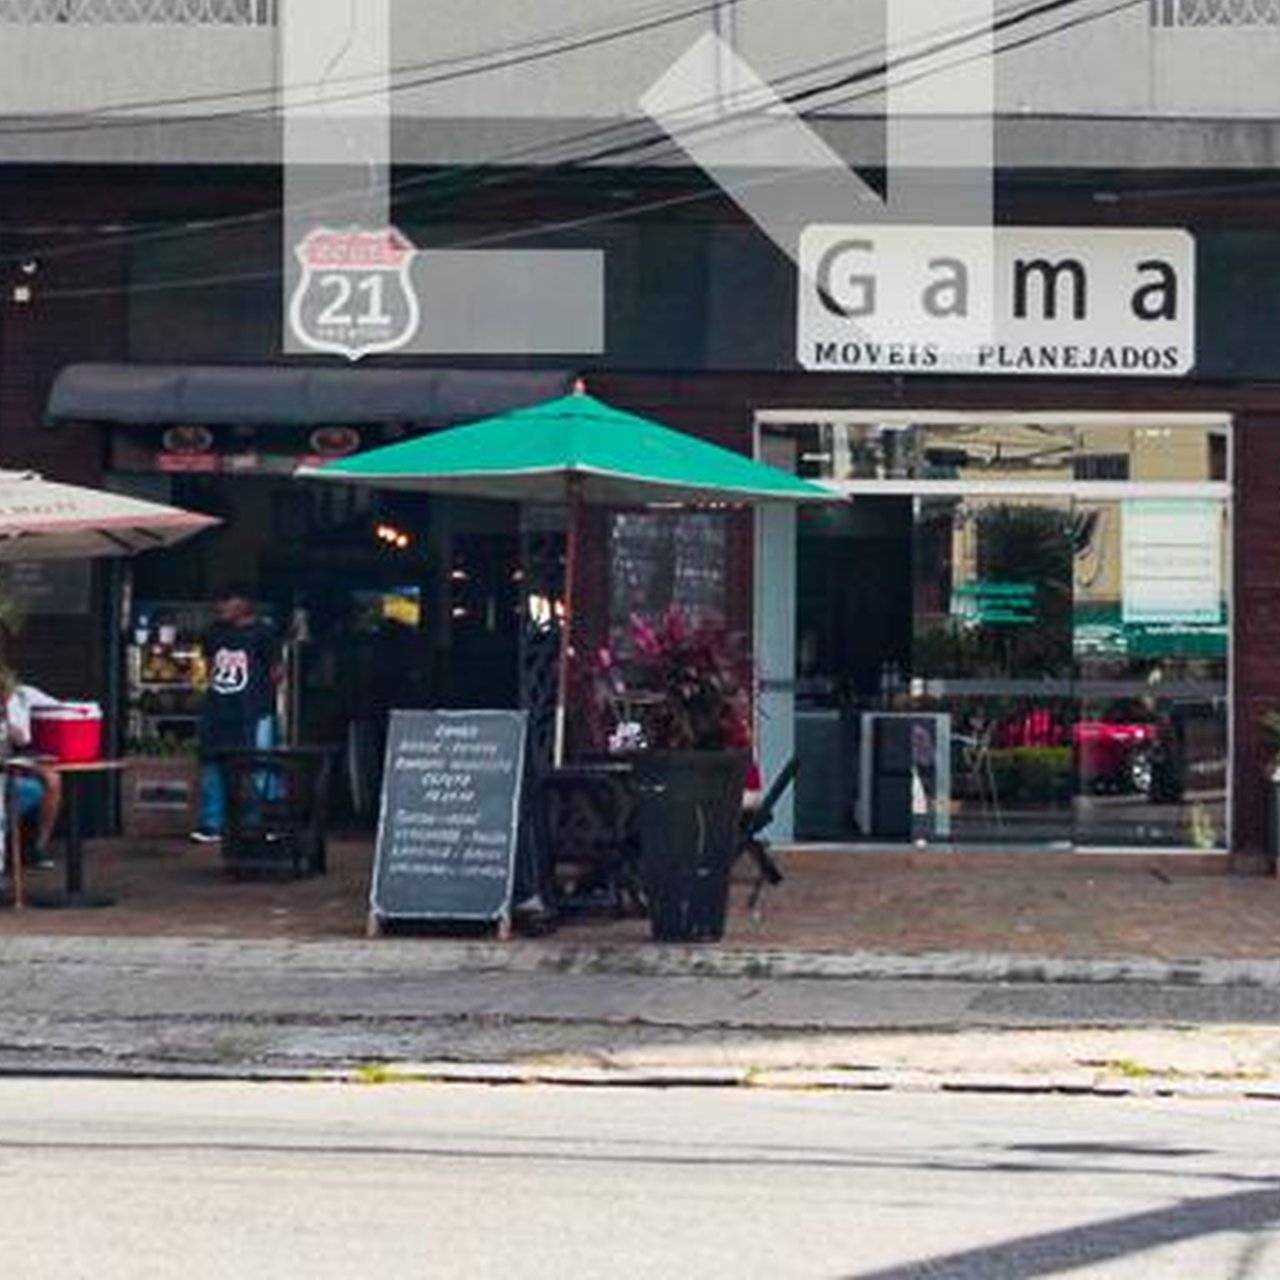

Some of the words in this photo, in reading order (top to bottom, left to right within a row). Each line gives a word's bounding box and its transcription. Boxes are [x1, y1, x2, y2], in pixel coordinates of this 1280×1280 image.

[317, 273, 392, 325] 21
[816, 238, 1178, 322] Gama
[815, 342, 939, 367] MOVEIS
[978, 343, 1179, 370] PLANEJADOS
